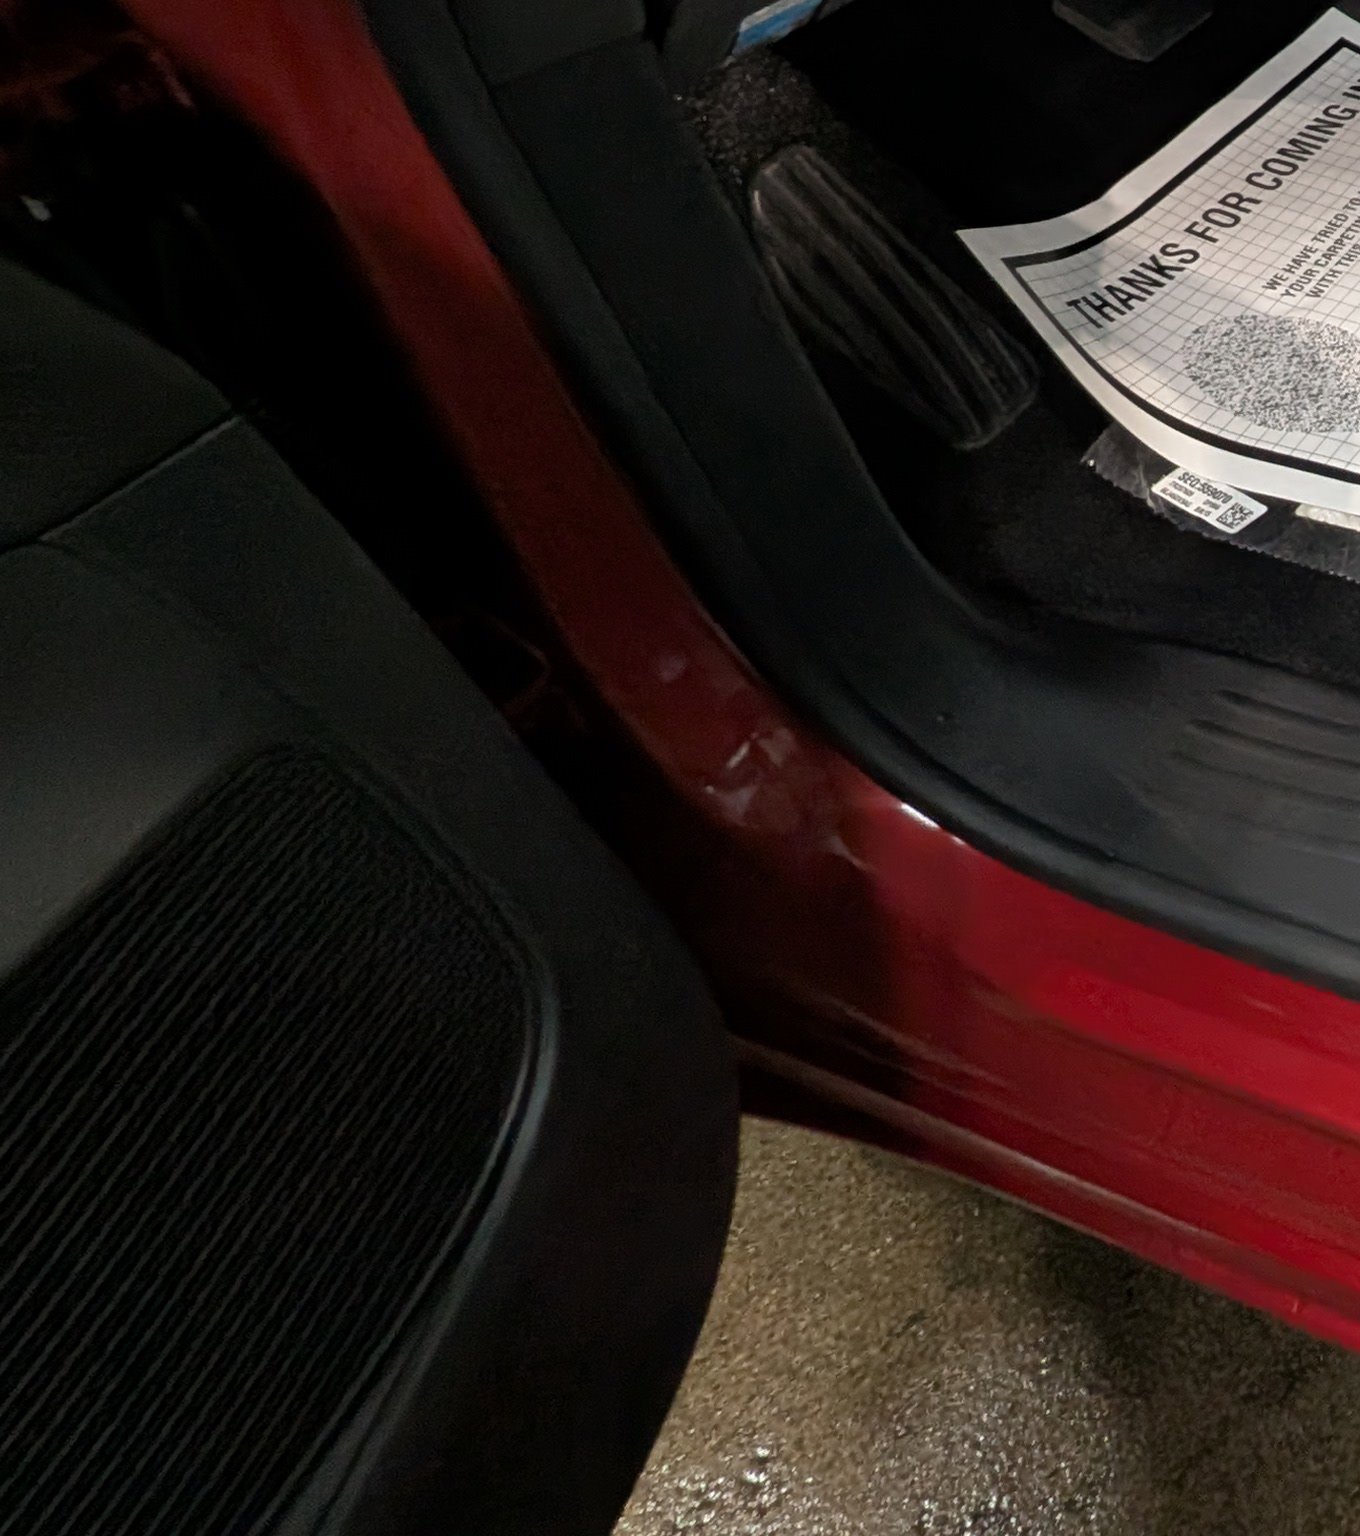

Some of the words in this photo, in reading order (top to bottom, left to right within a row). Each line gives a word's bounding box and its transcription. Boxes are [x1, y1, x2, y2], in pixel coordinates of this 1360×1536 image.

[1067, 242, 1200, 328] THANKS
[1184, 192, 1262, 243] FOR
[1246, 104, 1360, 191] COMING
[1262, 272, 1289, 291] WE
[1282, 245, 1318, 274] HAVE
[1311, 213, 1348, 244] TRIED
[1280, 268, 1320, 299] YOUR
[1305, 268, 1343, 299] WITH
